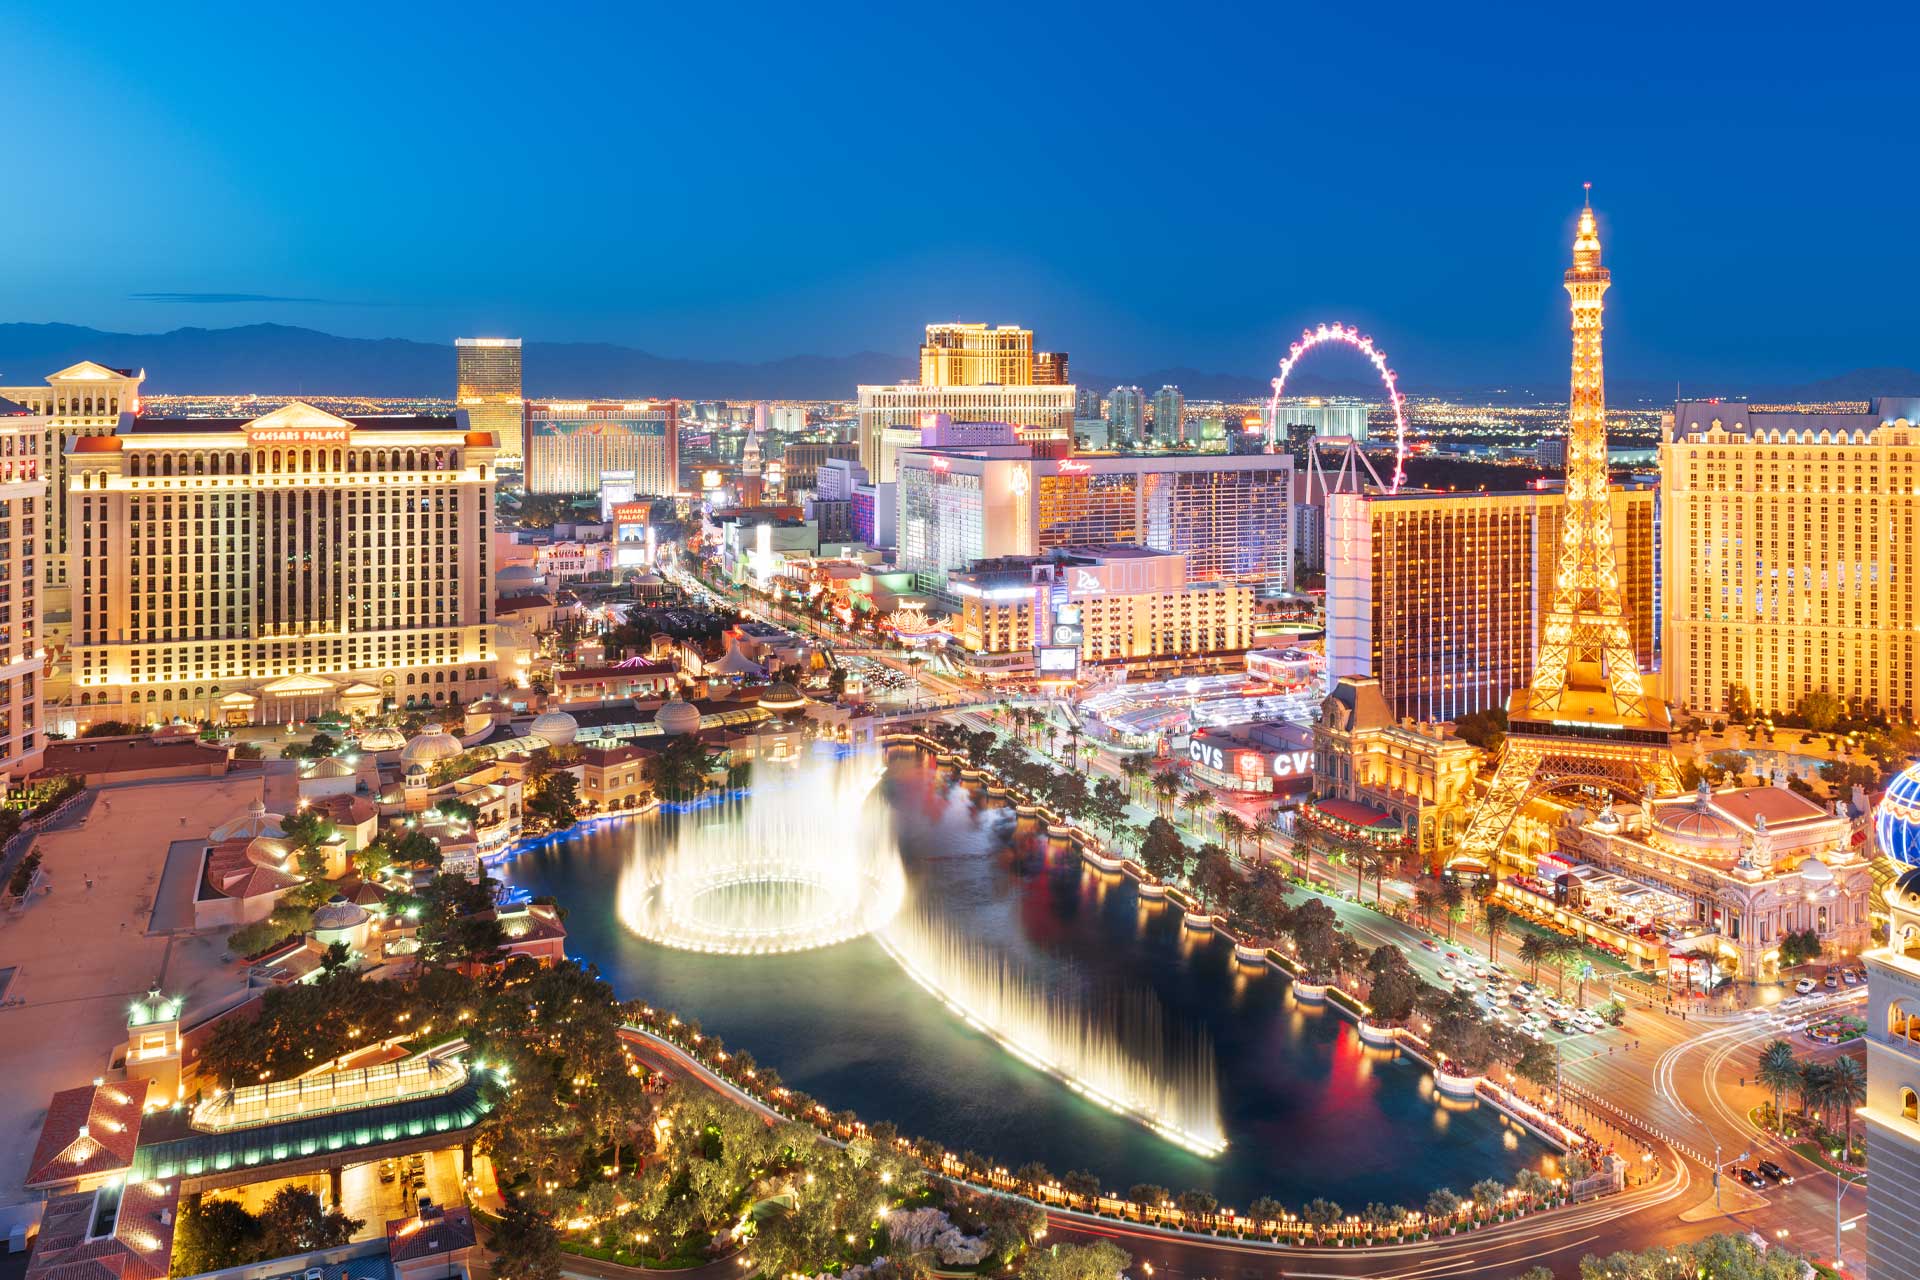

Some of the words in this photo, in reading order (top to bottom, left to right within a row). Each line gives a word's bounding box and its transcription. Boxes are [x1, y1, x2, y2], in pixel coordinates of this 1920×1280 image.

[252, 431, 300, 441] CAESARS
[303, 431, 345, 440] PALACE
[1190, 740, 1223, 770] CVS
